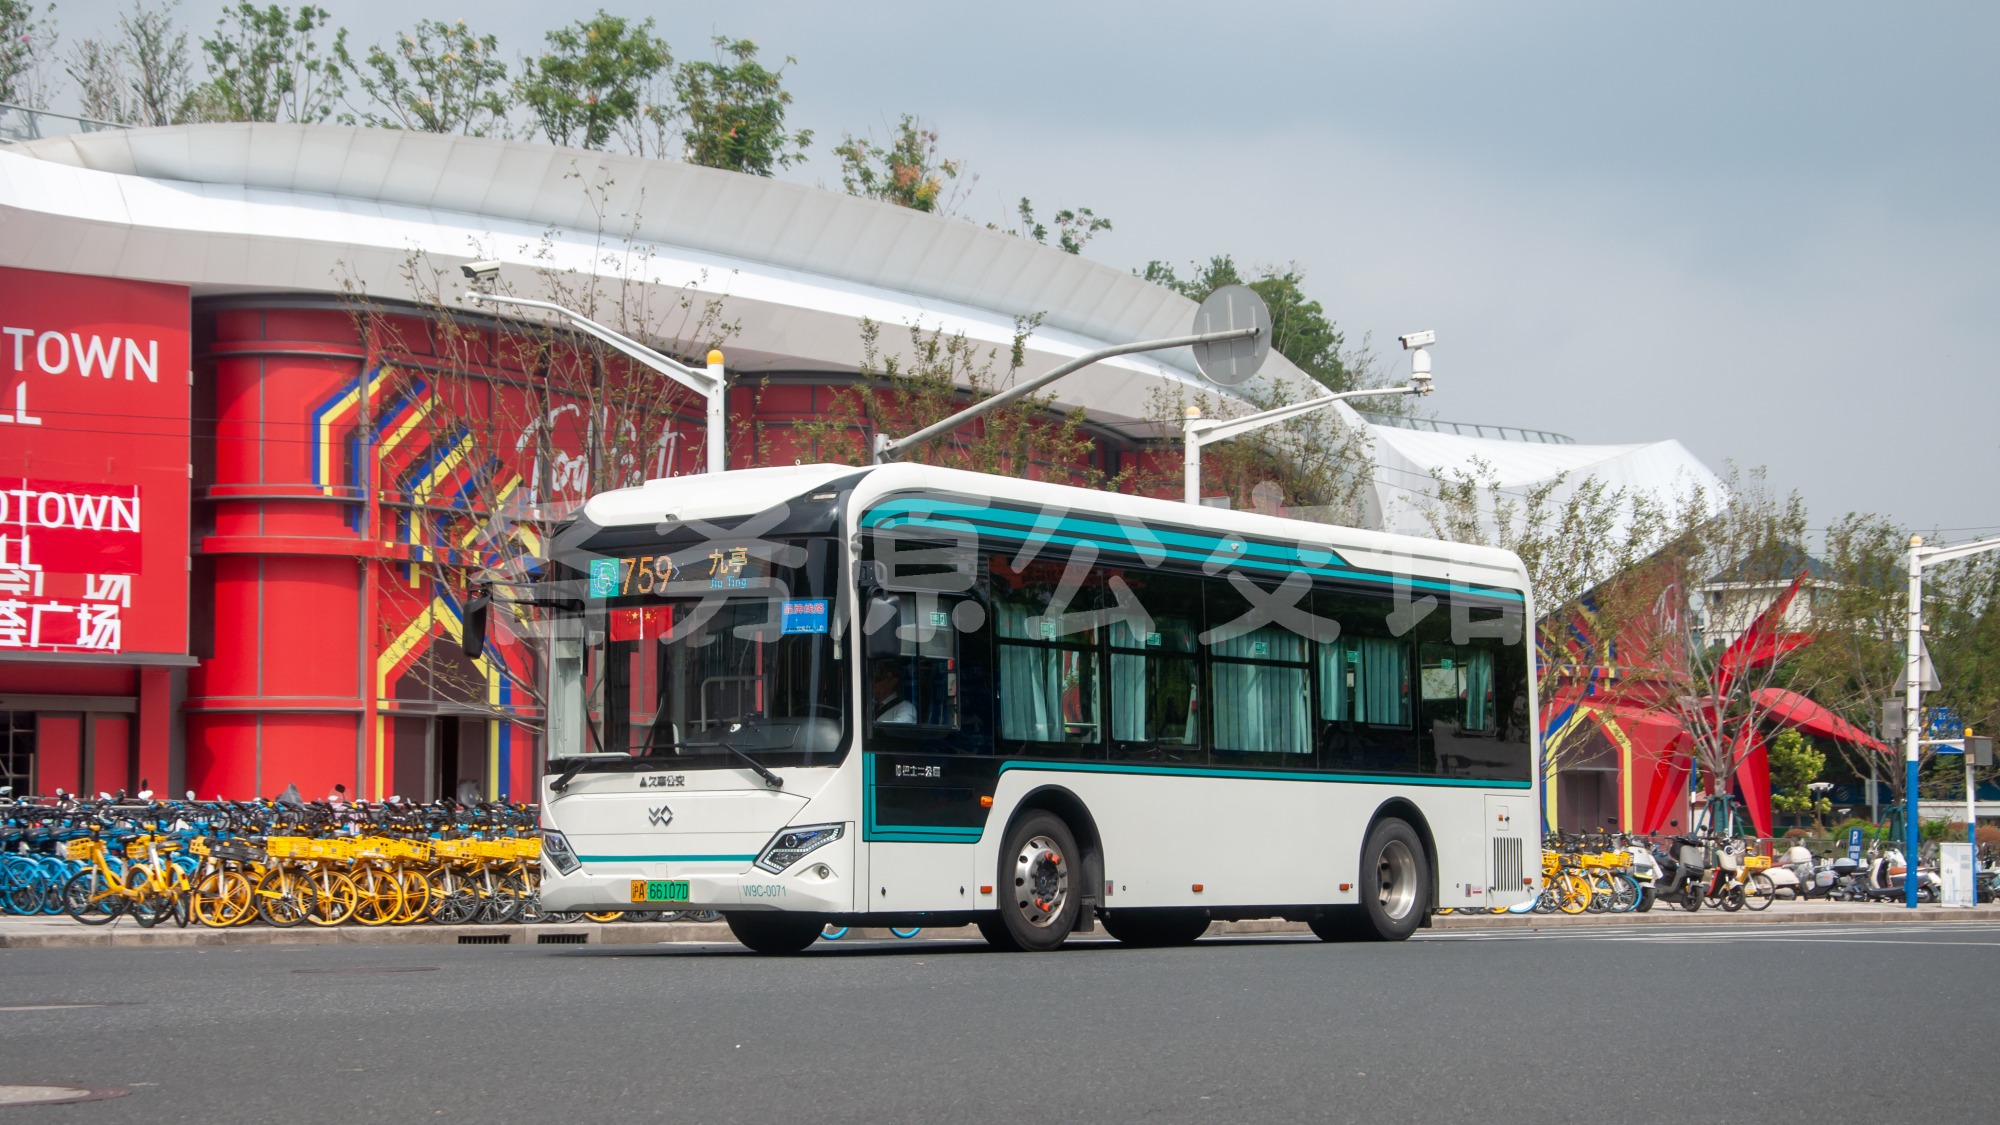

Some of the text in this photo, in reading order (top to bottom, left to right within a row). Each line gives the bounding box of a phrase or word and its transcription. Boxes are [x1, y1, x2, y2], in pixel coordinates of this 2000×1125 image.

[709, 547, 748, 575] 九亭
[620, 556, 673, 595] 759
[727, 576, 747, 589] Ting
[743, 885, 787, 897] W9C-0071
